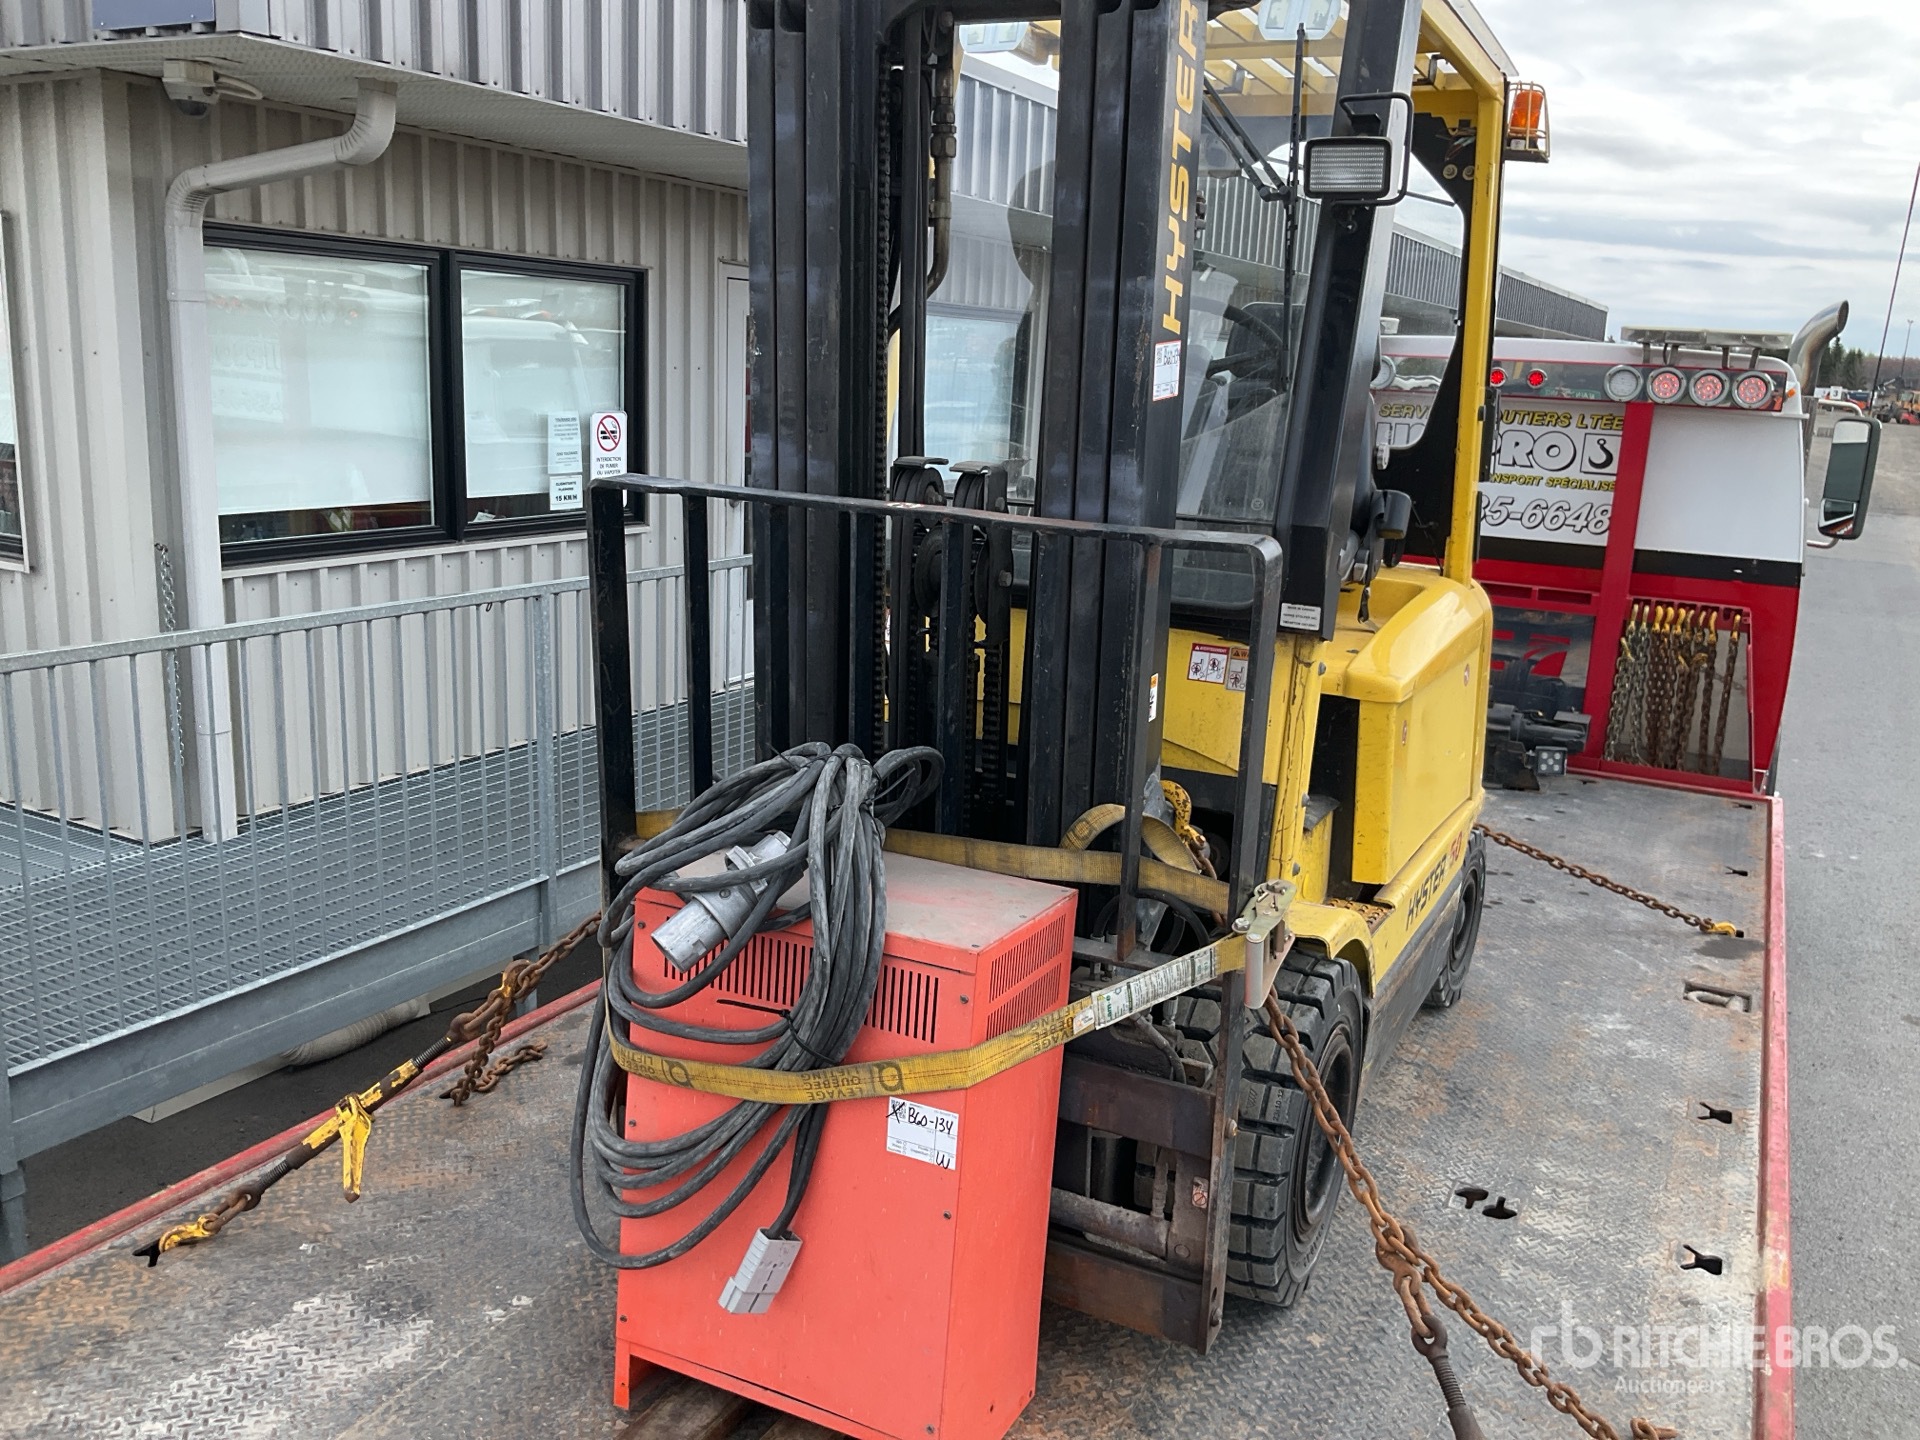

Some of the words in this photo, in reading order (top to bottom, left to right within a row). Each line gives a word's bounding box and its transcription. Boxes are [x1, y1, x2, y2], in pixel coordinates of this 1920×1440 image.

[1162, 0, 1199, 335] HYSTER
[1500, 409, 1572, 429] UTIERS
[1491, 473, 1544, 487] NSPORT
[1405, 853, 1447, 931] HYSTER
[803, 1074, 862, 1091] QUEBEC
[807, 1086, 862, 1101] LEVAGE
